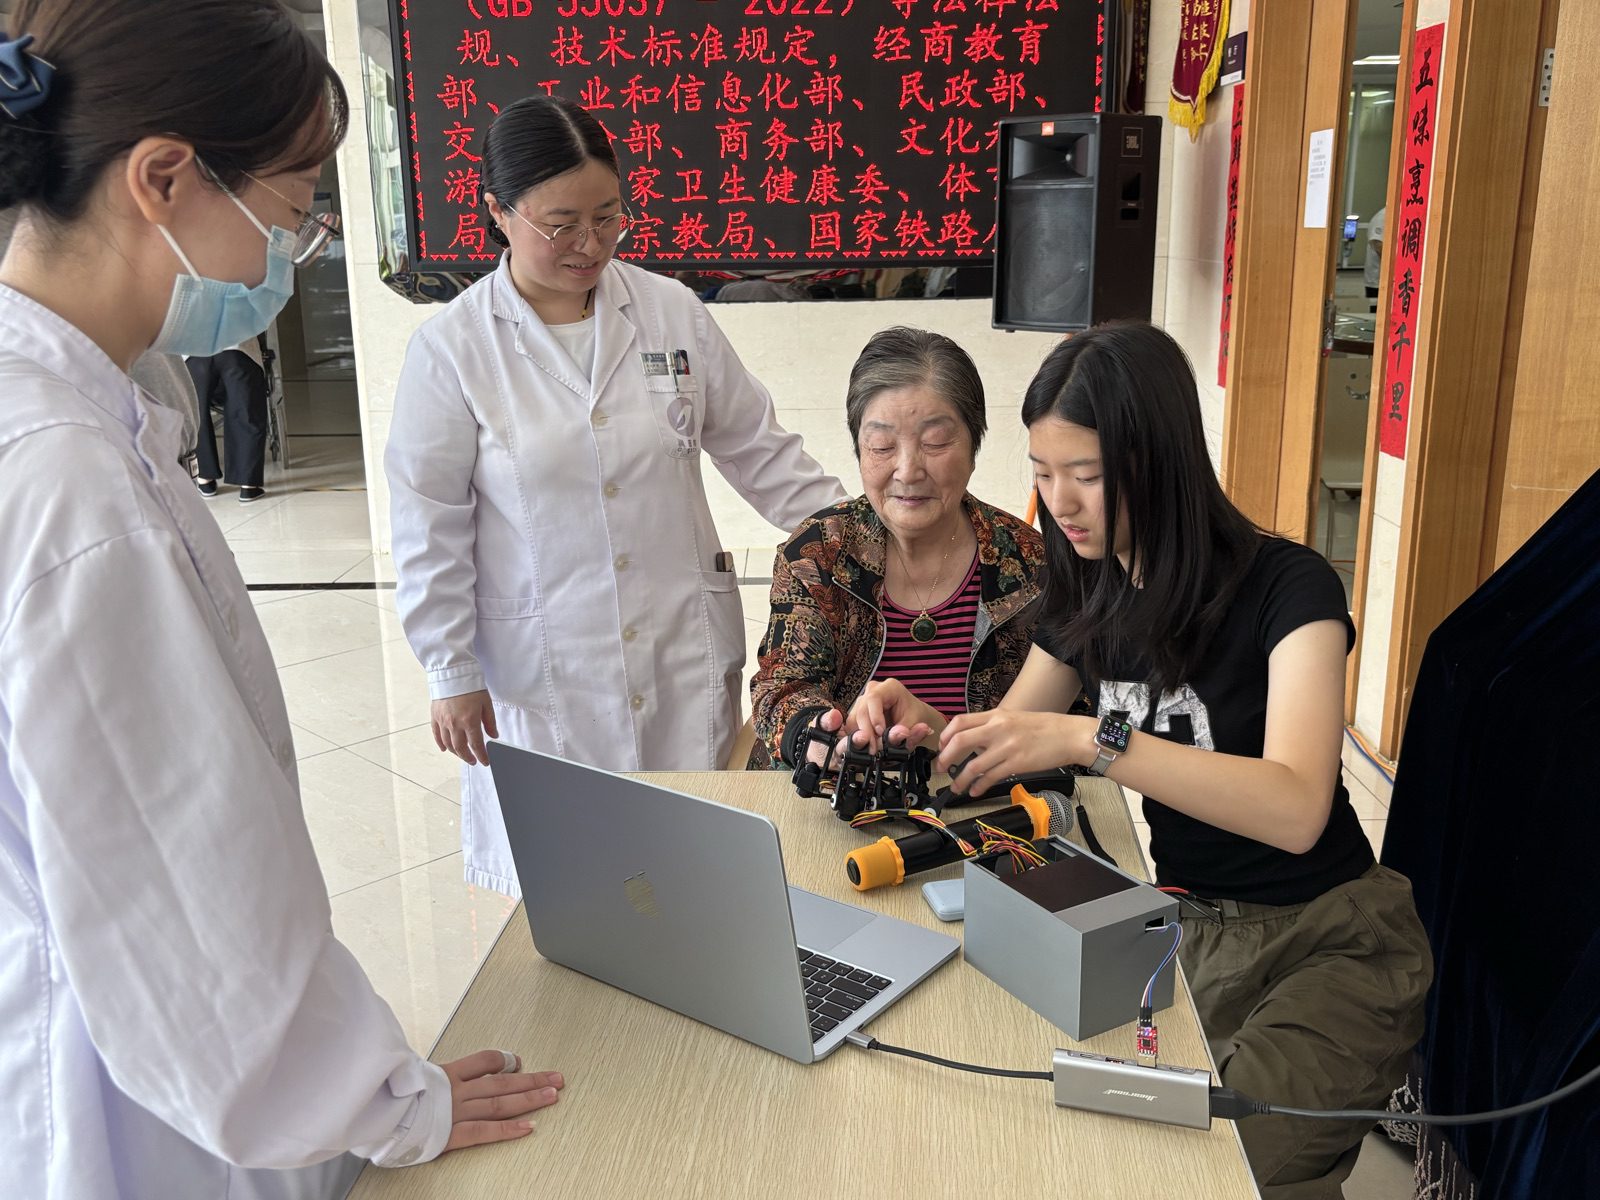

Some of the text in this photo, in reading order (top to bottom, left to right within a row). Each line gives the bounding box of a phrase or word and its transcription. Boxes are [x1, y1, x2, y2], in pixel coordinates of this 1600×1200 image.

[1388, 47, 1433, 421] 五味烹调香千里
